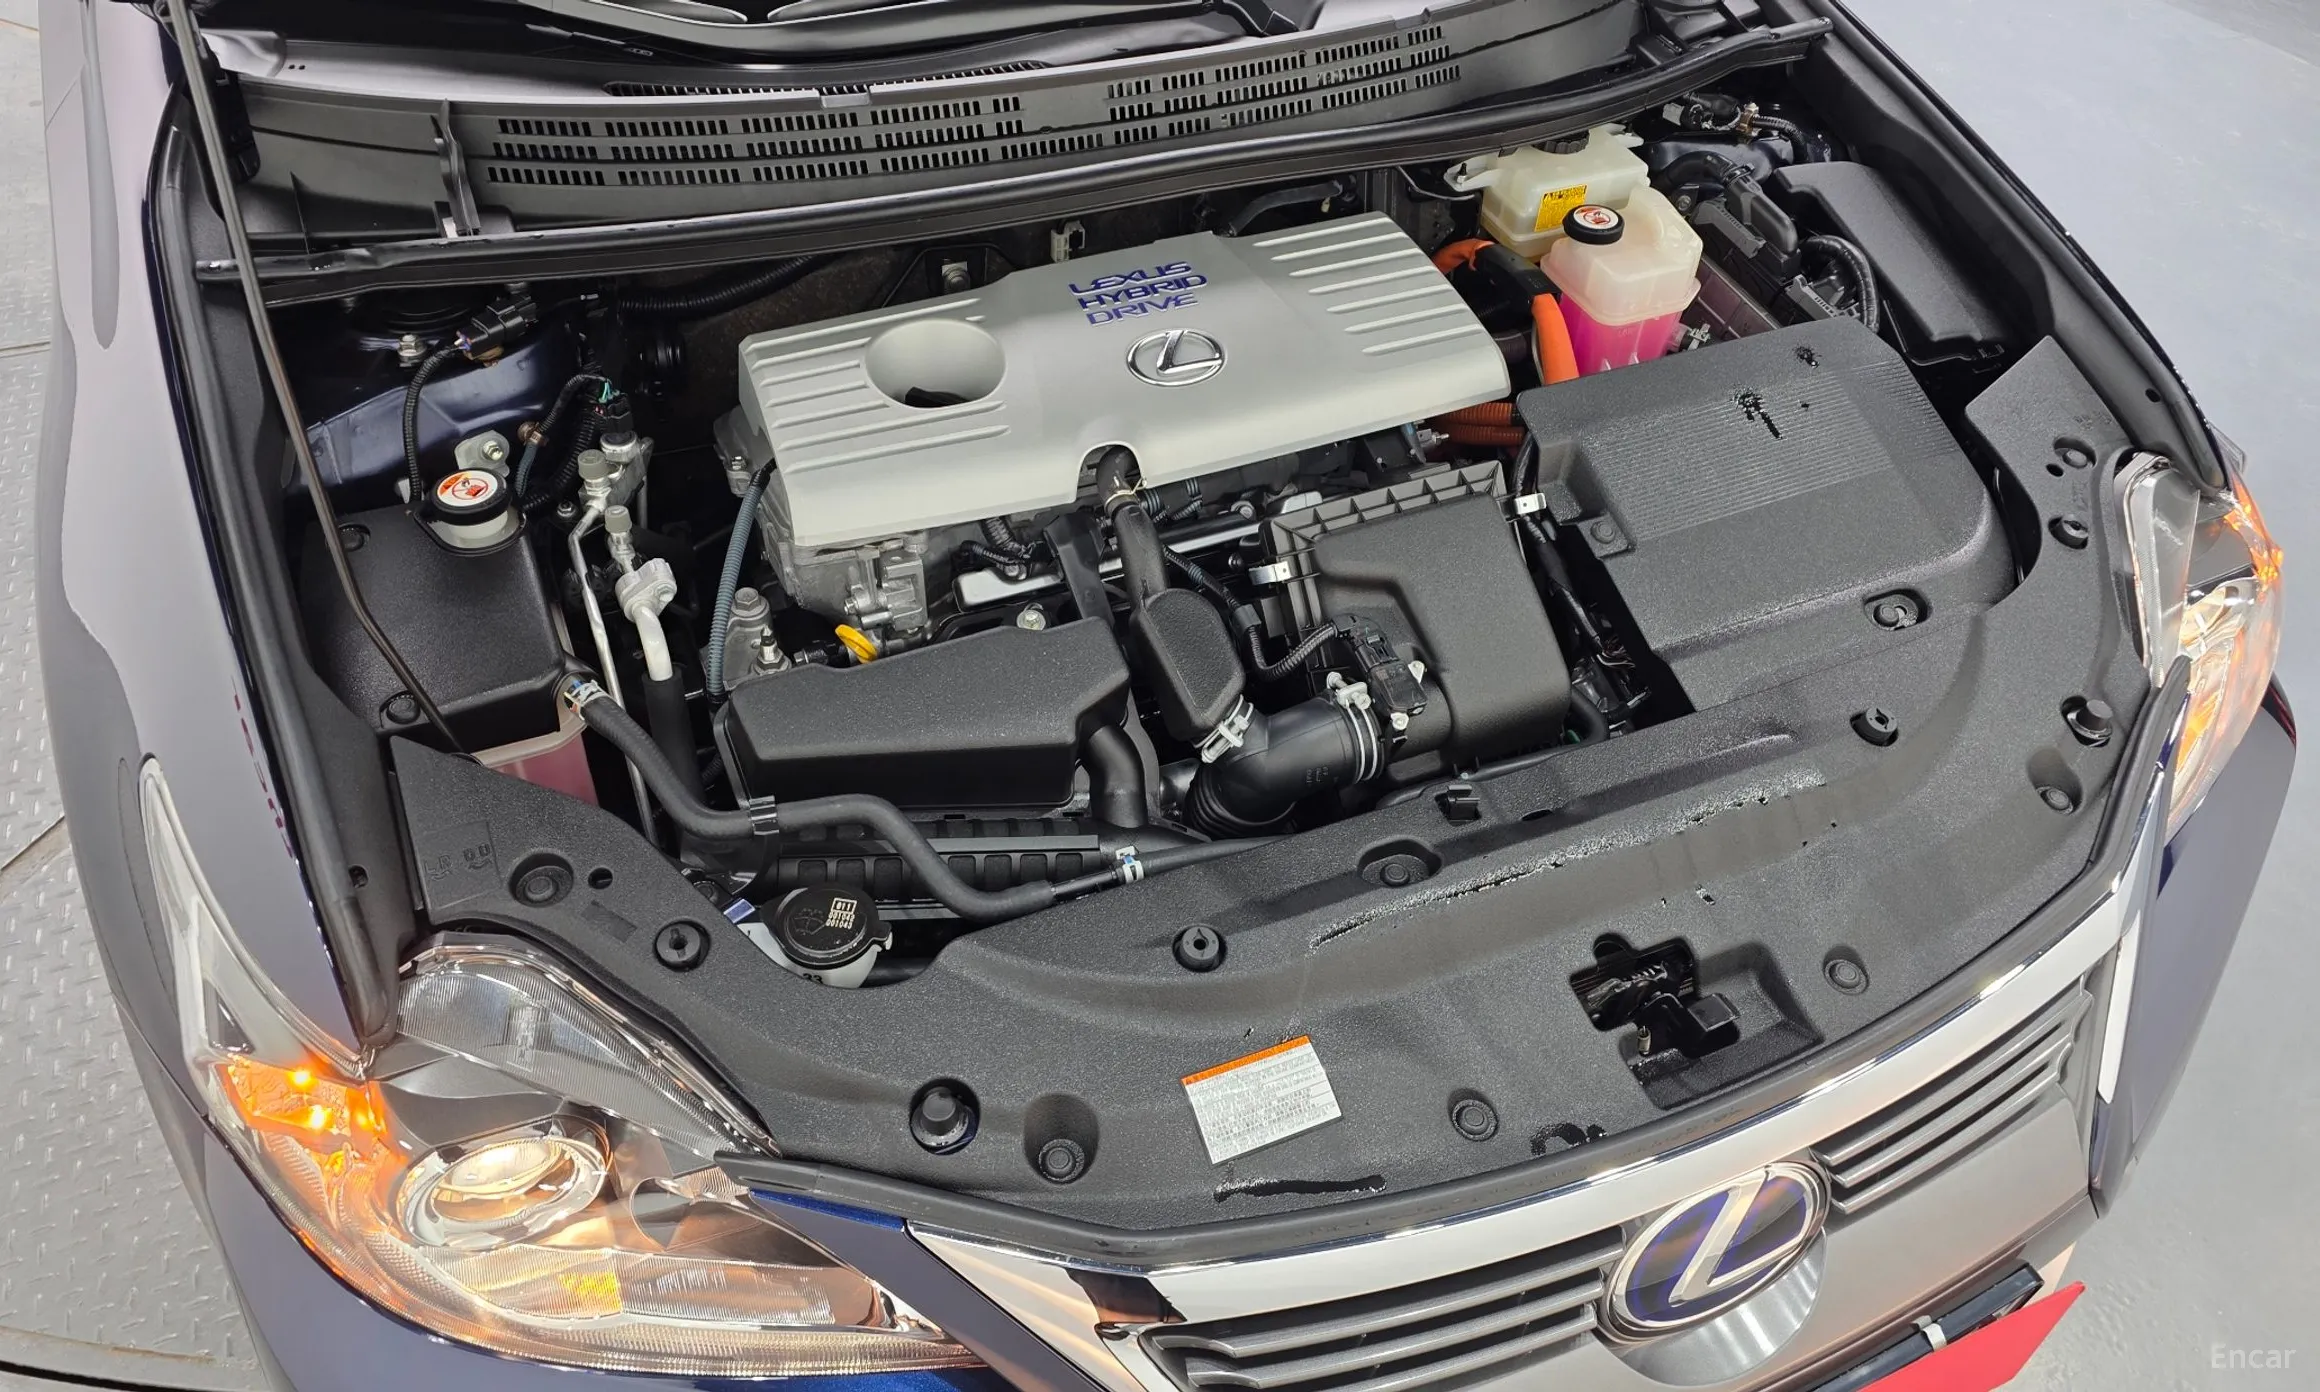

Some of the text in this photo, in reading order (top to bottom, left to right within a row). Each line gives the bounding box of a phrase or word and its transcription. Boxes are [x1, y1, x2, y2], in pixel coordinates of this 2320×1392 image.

[1068, 261, 1193, 295] LEXUS
[1077, 275, 1208, 310] HYBRID
[1086, 293, 1199, 325] DRIVE
